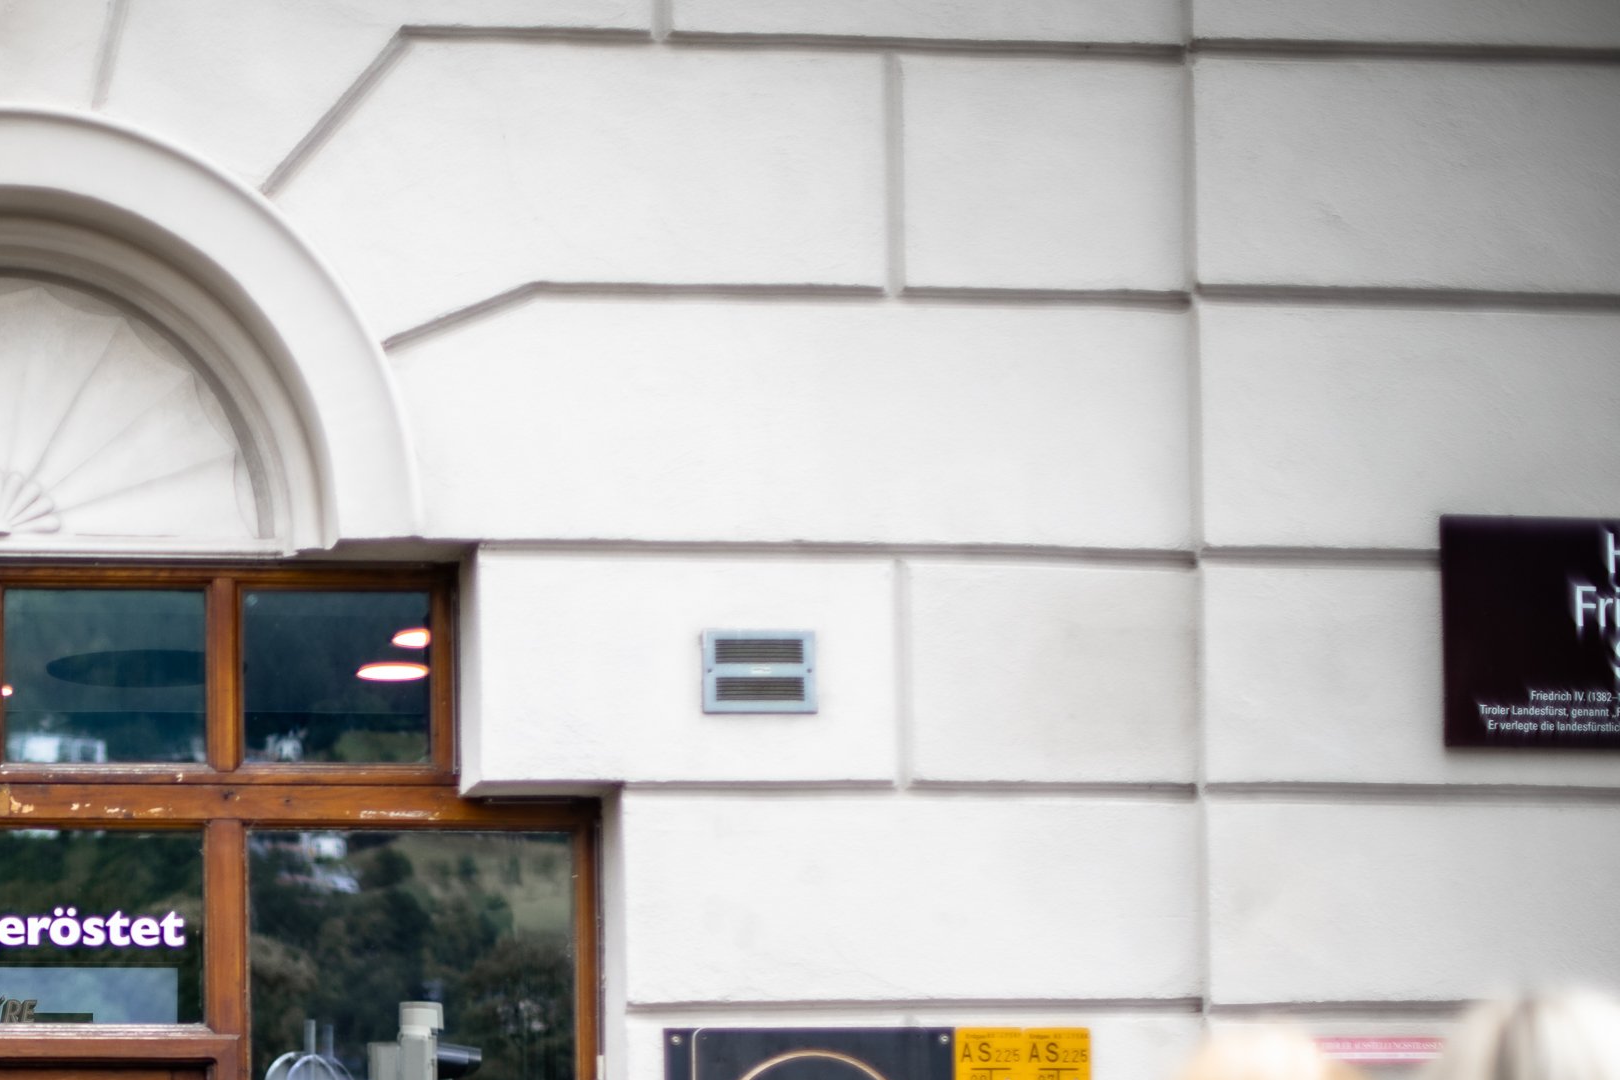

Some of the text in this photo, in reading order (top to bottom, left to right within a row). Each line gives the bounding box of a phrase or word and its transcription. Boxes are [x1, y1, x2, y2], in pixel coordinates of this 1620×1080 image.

[1530, 690, 1572, 701] Friedrich
[1575, 691, 1586, 701] IV.
[1480, 704, 1510, 715] Tiroler
[1512, 705, 1569, 718] Landesfürst,
[1571, 708, 1609, 718] genannt
[1488, 720, 1498, 730] Er
[1500, 721, 1538, 732] verlegte
[1541, 721, 1554, 731] die
